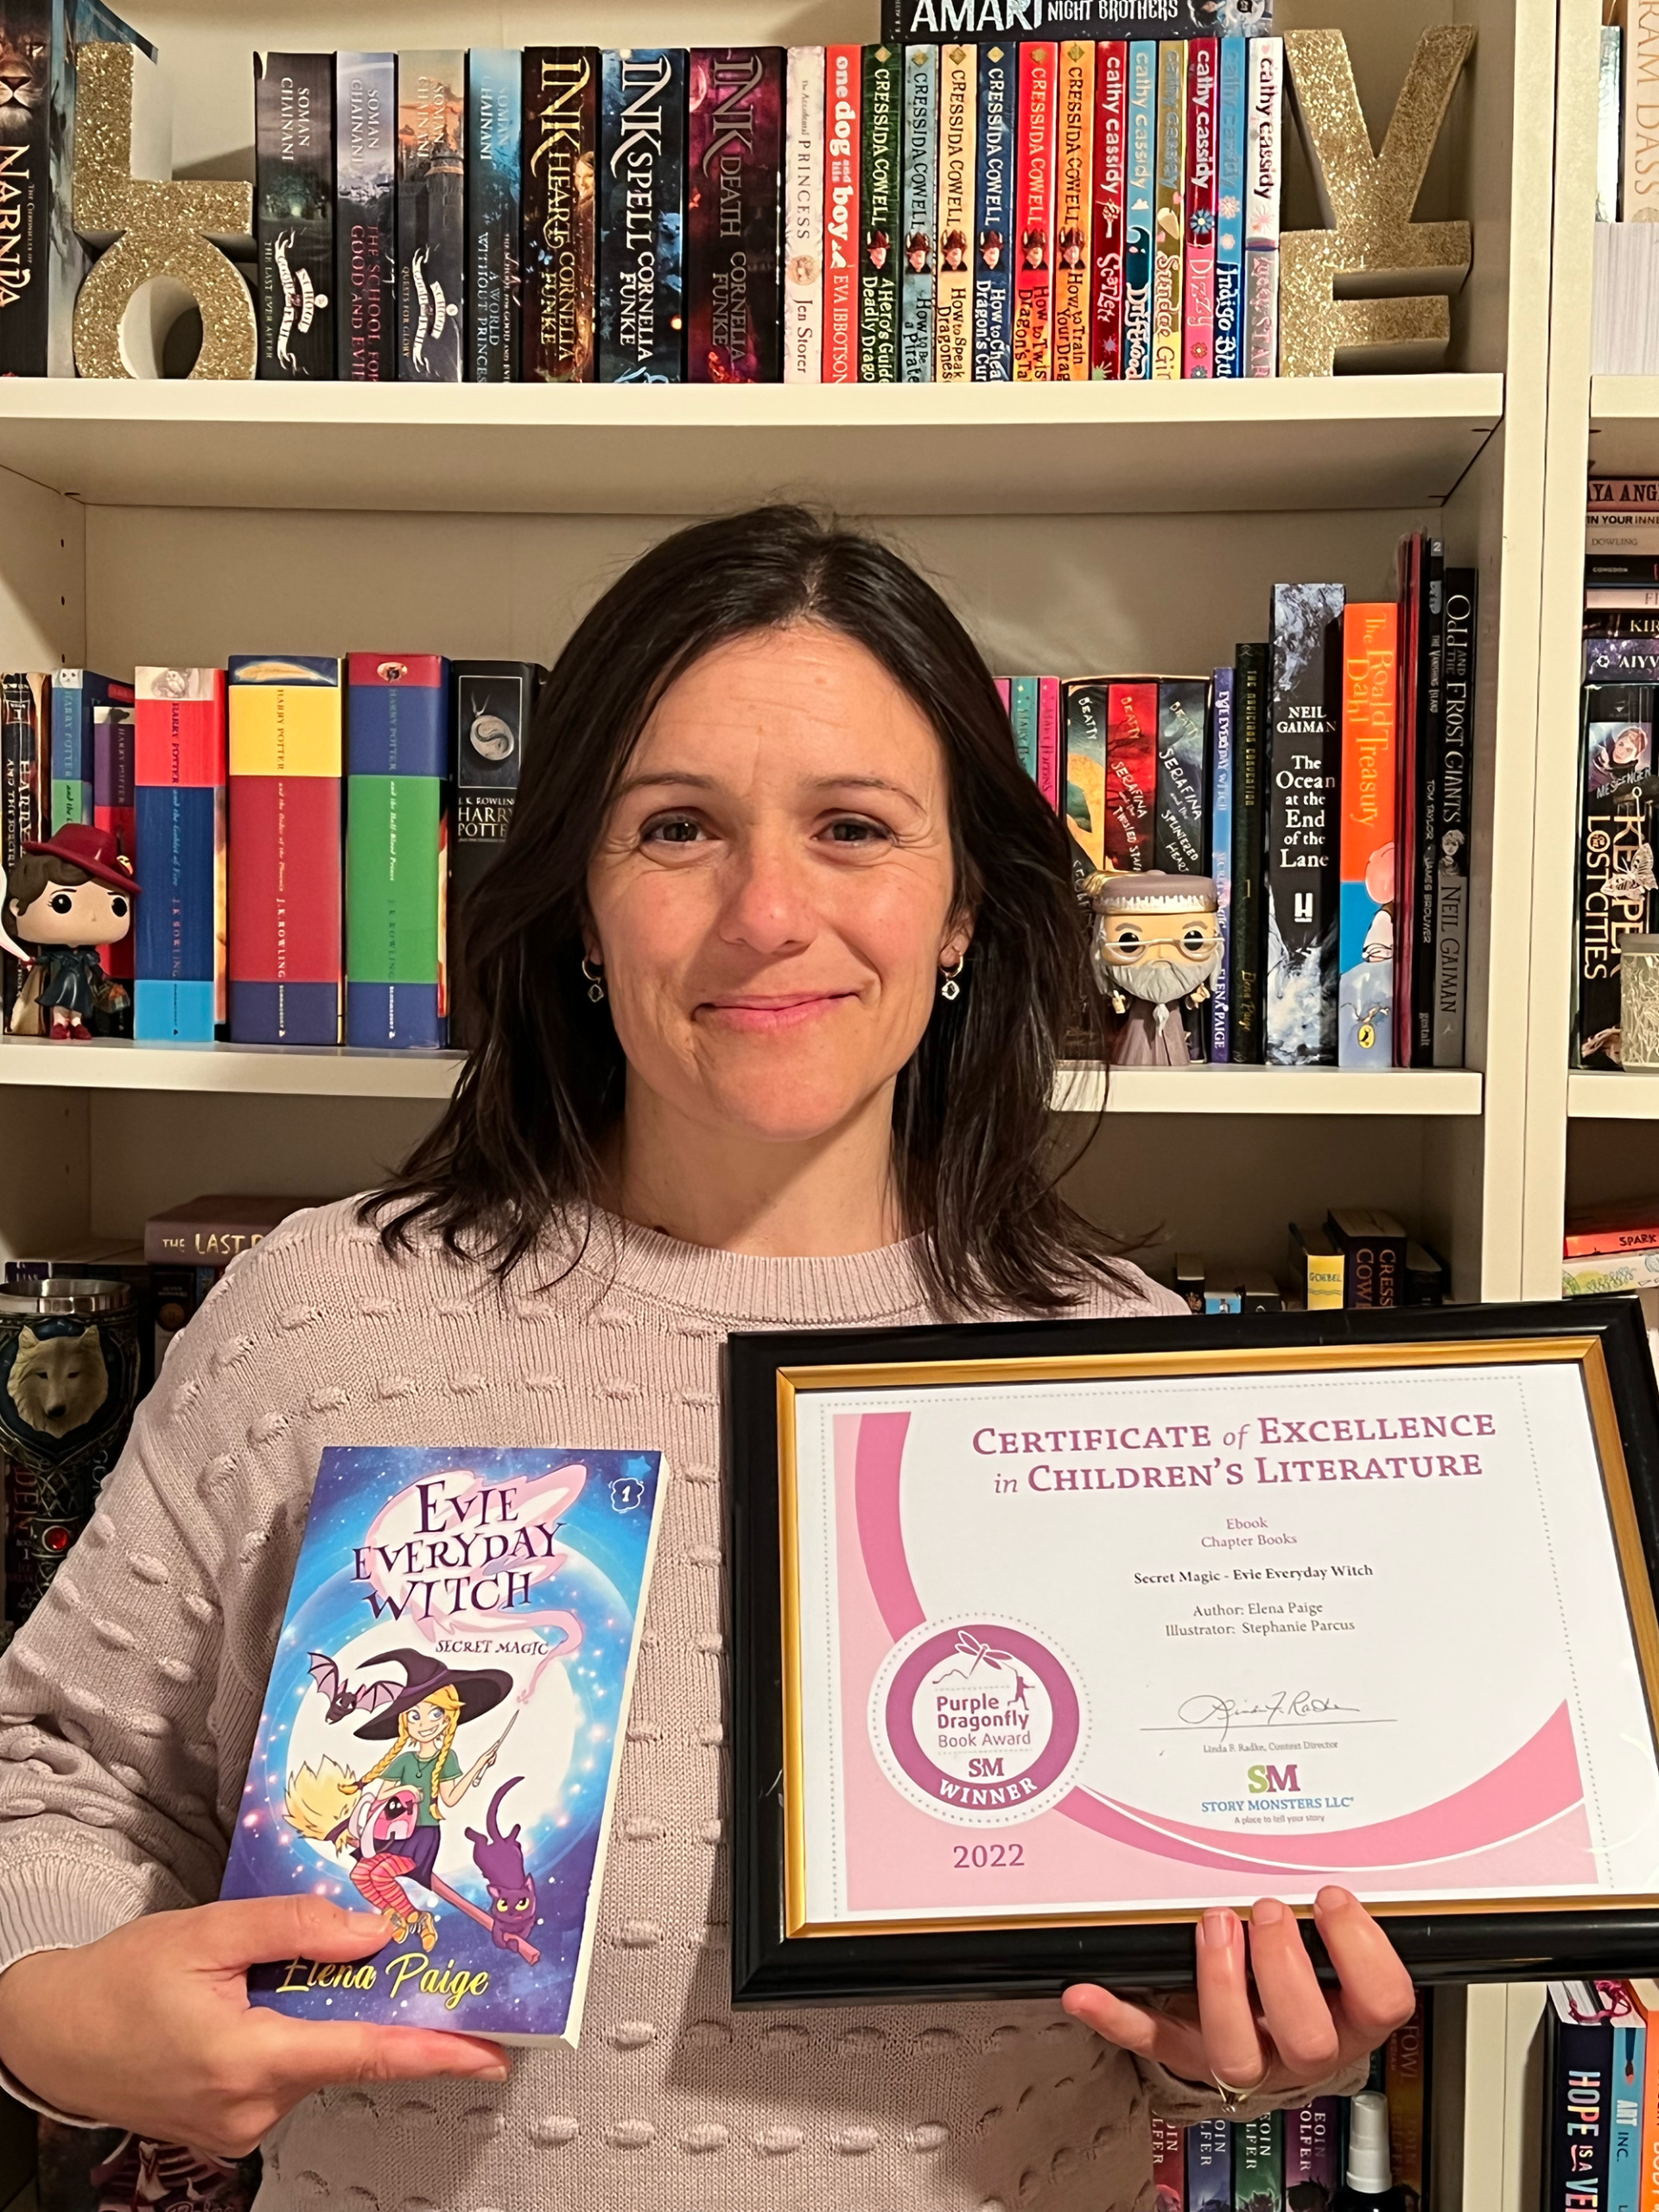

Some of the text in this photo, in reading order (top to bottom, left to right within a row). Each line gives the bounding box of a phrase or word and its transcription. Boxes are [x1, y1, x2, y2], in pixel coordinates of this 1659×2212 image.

[910, 0, 1042, 31] AMARI
[1047, 0, 1094, 22] NIGHT
[1098, 0, 1179, 22] BROTHERS
[282, 78, 309, 161] SOMAN CHAINANI
[351, 79, 378, 165] SOMAN CHAINANI
[1132, 53, 1150, 188] cathy cassidy
[1192, 50, 1211, 188] cathy cassidy
[1634, 1, 1659, 195] RAM DASS
[828, 56, 855, 241] one dog boy
[871, 68, 889, 226] CRESSIDA COWELL
[947, 70, 965, 226] CRESSIDA COWELL
[985, 68, 1003, 226] CRESSIDA COWELL
[1027, 67, 1046, 225] CRESSIDA COWELL
[1065, 67, 1082, 225] CRESSIDA COWELL
[1102, 57, 1122, 194] cathy cassidy
[1255, 58, 1274, 200] cathy cassidy
[910, 73, 927, 230] CRESSIDA COWELL
[798, 140, 810, 239] PRINCESS
[0, 144, 31, 307] NARNIA
[367, 226, 378, 256] THE
[351, 226, 365, 380] GOOD AND EVIL
[367, 264, 379, 343] SCHOOL
[541, 251, 575, 361] CORNELIA FUNKE
[620, 251, 655, 362] CORNELIA FUNKE
[712, 251, 746, 361] CORNELIA FUNKE
[1216, 269, 1236, 330] Indigo
[796, 300, 816, 372] Jen Storer
[833, 275, 849, 383] EVA IBBOTSON
[951, 289, 965, 378] How to Speak
[1592, 537, 1637, 546] DOWLING
[1277, 721, 1336, 733] GAIMAN
[1288, 707, 1326, 718] NEIL
[1346, 613, 1393, 827] The Roald Dahl Treasury
[1158, 748, 1202, 821] SERAFINA
[1276, 771, 1335, 788] Ocean
[1291, 755, 1321, 769] The
[1110, 761, 1147, 817] SERAFINA
[1286, 792, 1325, 805] at the
[1427, 780, 1435, 801] TOM
[1440, 594, 1471, 1014] Odd FROST GIANTS NEIL GAIMAN
[1284, 831, 1325, 844] of the
[1286, 810, 1325, 827] End
[1425, 804, 1435, 840] TAYLOR
[1281, 849, 1329, 868] Lane
[1422, 894, 1433, 943] BROUWER
[1584, 892, 1608, 980] CITIES
[162, 1234, 245, 1254] THE LAST
[1618, 1234, 1657, 1247] SPARK
[1309, 1272, 1342, 1282] GOEBEL
[972, 1414, 1497, 1456] CERTIFICATE of EXCELLENCE
[621, 1486, 631, 1503] 1
[995, 1453, 1483, 1494] in CHILDREN'S LITERATURE
[414, 1480, 518, 1534] EVIE
[1226, 1517, 1268, 1529] Ebook
[352, 1522, 567, 1581] EVERYDAY
[1201, 1534, 1297, 1549] Chapter Books
[362, 1572, 532, 1621] WITCH
[1134, 1564, 1373, 1585] Secret Magic Evie Everyday Witch
[1166, 1620, 1355, 1637] Illustrator: Stephanie Parcus
[1193, 1602, 1323, 1617] Author: Elena Paige
[435, 1641, 550, 1656] SECRET MAGIC
[937, 1694, 999, 1713] Purple
[938, 1710, 1029, 1732] Dragonfly
[938, 1731, 1030, 1747] Book Award
[939, 1777, 1037, 1805] WINNER
[969, 1758, 1004, 1777] SM
[1247, 1764, 1300, 1793] SM
[1202, 1802, 1243, 1812] STORY
[1248, 1798, 1321, 1811] MONSTERS
[953, 1844, 1025, 1868] 2022
[276, 1952, 488, 2010] Elena Paige
[1314, 2113, 1325, 2158] EOIN
[1567, 2070, 1601, 2171] HOPE IS A
[1616, 2100, 1637, 2163] ART INC.
